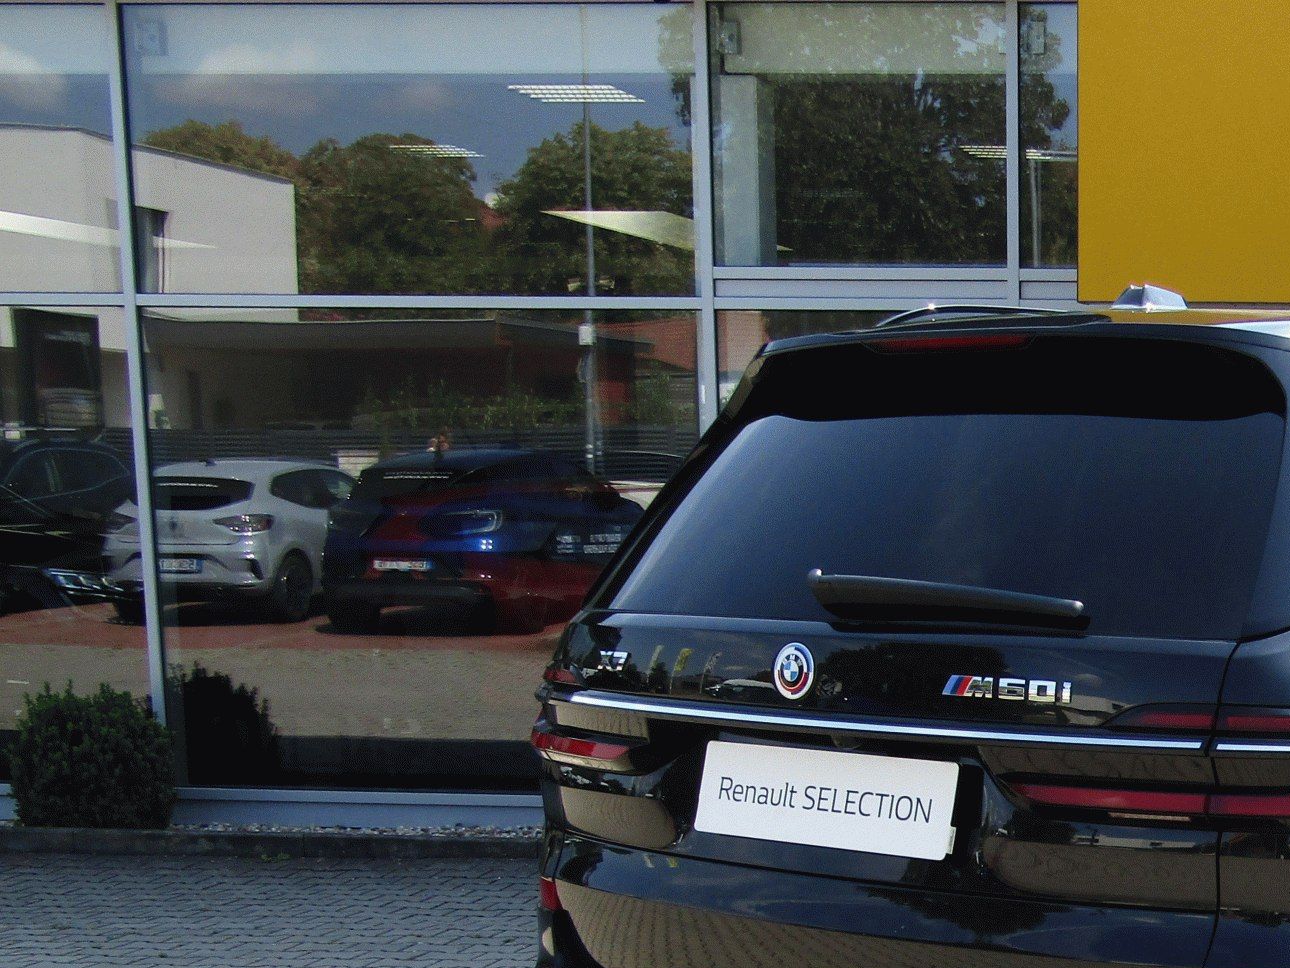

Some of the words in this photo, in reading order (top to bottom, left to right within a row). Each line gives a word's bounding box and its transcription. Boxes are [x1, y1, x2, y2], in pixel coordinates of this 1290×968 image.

[597, 650, 630, 671] X7
[963, 676, 1072, 703] M60i
[718, 776, 797, 808] Renault
[802, 785, 932, 823] SELECTION
